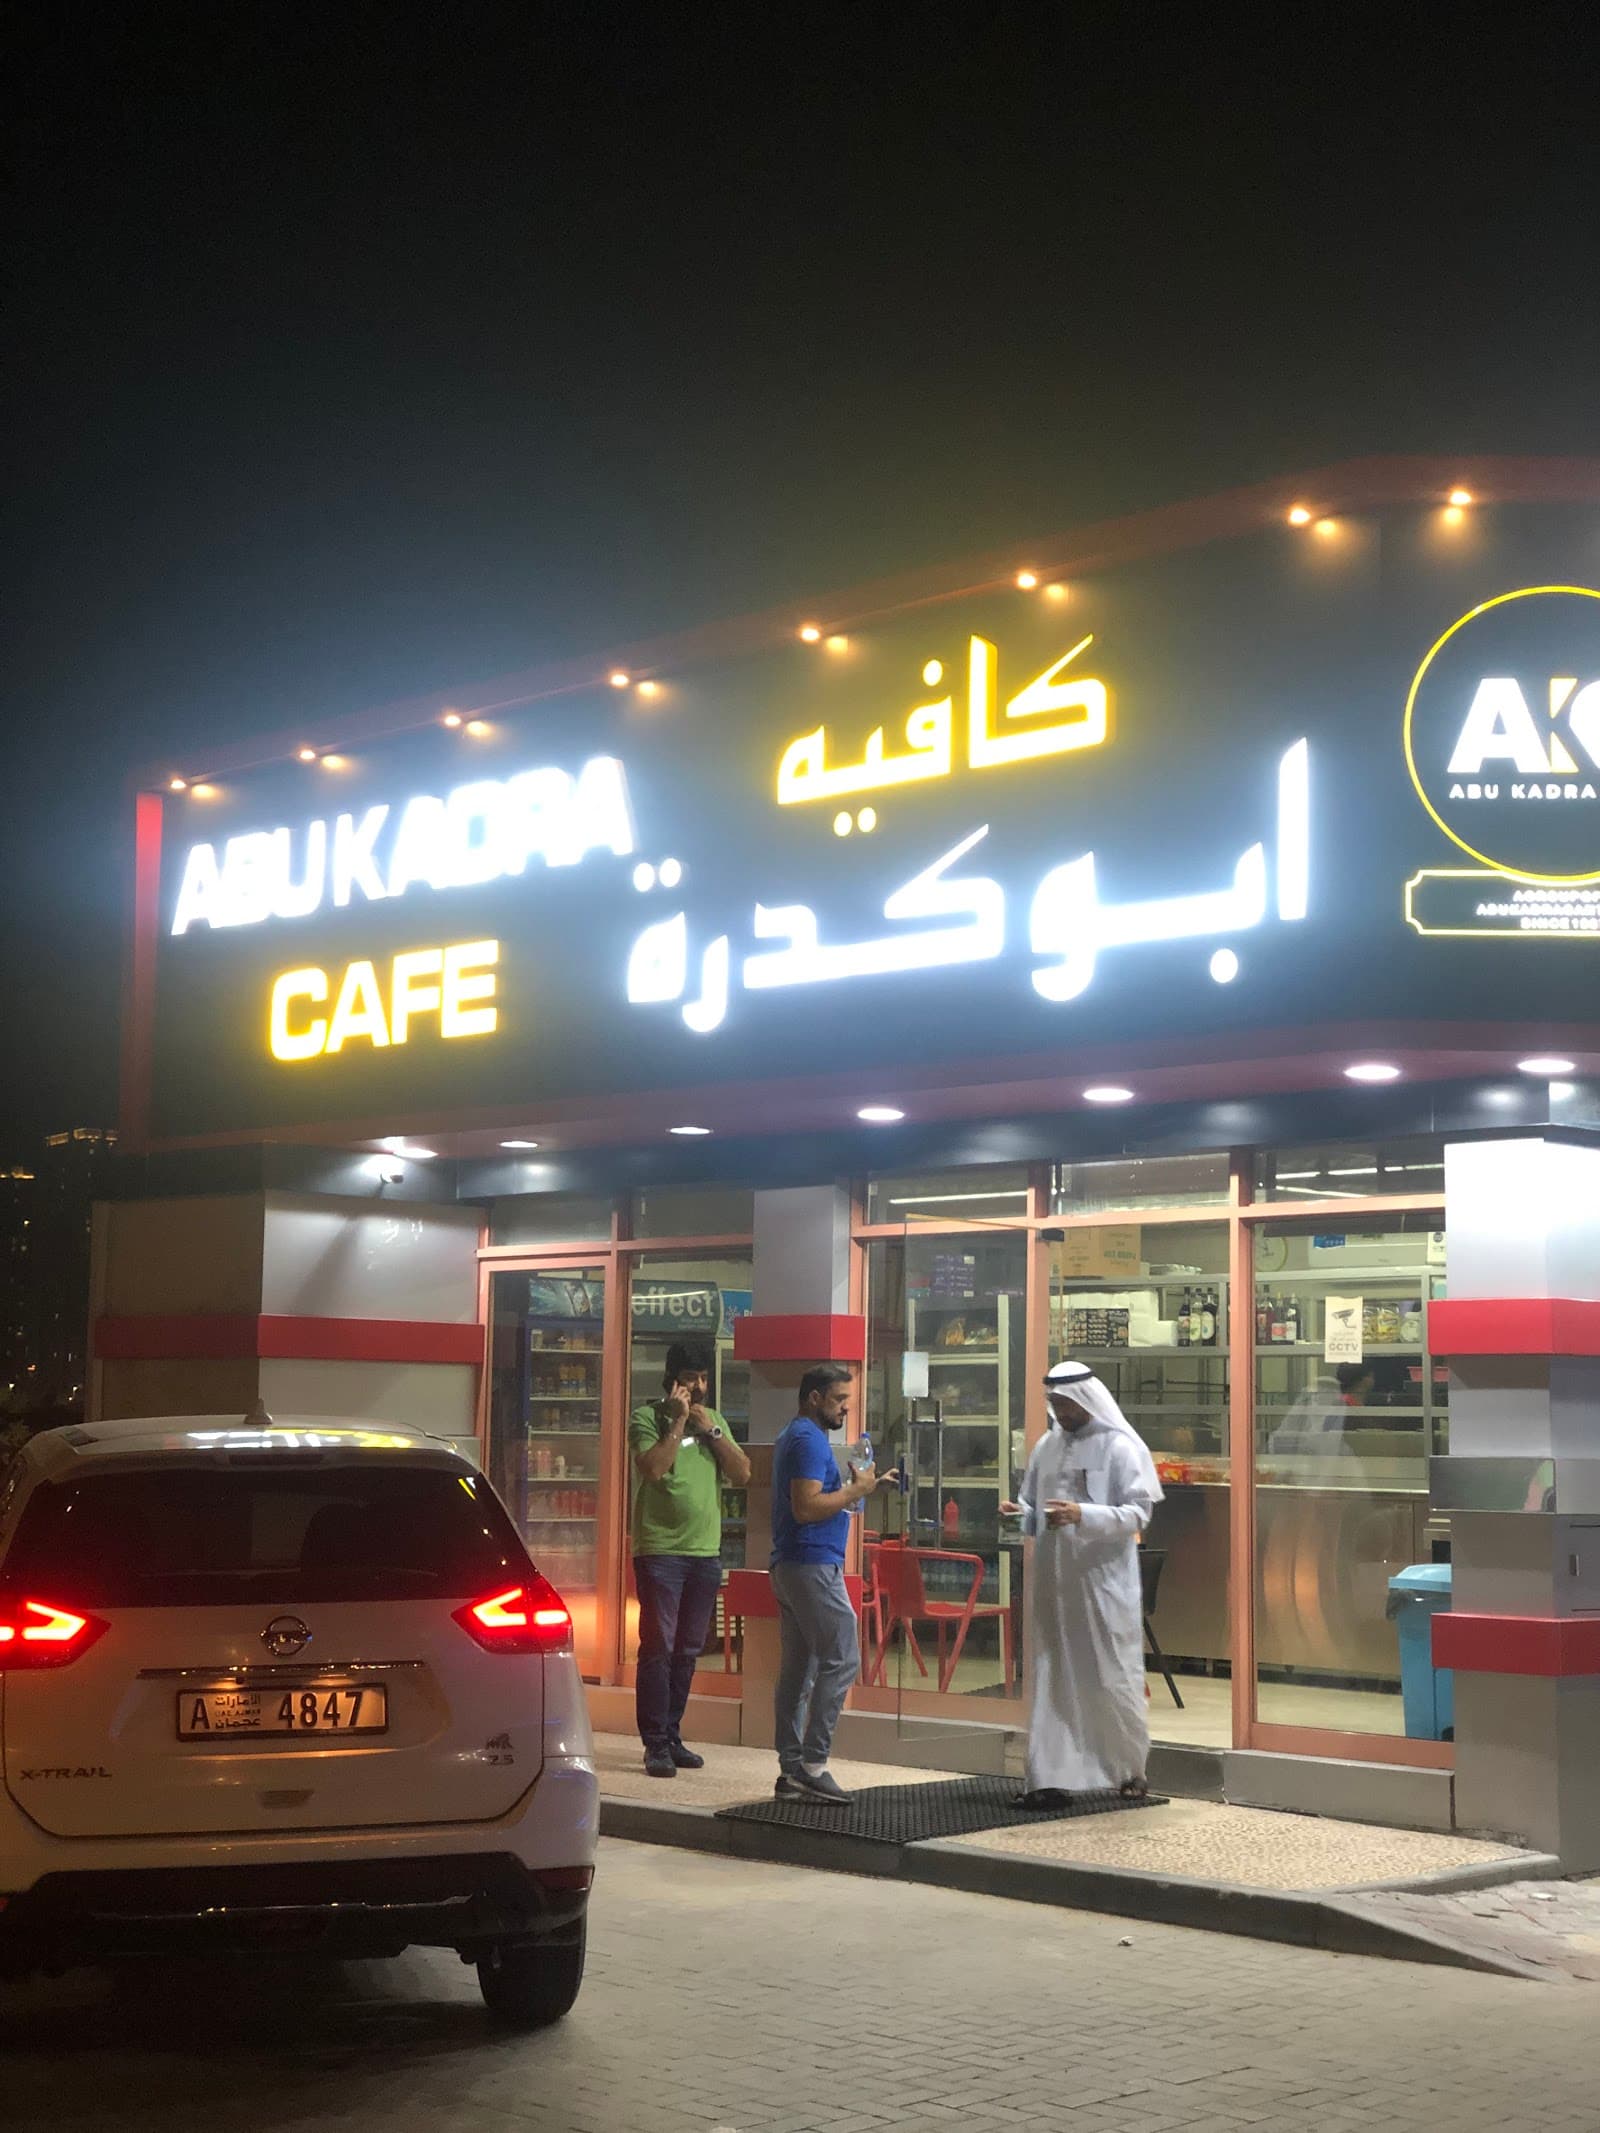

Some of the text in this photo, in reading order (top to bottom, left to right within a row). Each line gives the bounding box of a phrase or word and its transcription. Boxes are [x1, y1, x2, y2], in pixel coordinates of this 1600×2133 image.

[777, 633, 1109, 837] كافيه
[1449, 784, 1597, 799] ABU KADRA
[172, 756, 634, 935] ABU KADRA
[270, 939, 499, 1062] CAFE
[1329, 1343, 1359, 1351] CCTV
[191, 1698, 210, 1729] A
[215, 1718, 261, 1729] عجمان
[278, 1692, 363, 1729] 4847
[20, 1767, 112, 1780] X-TRAIL
